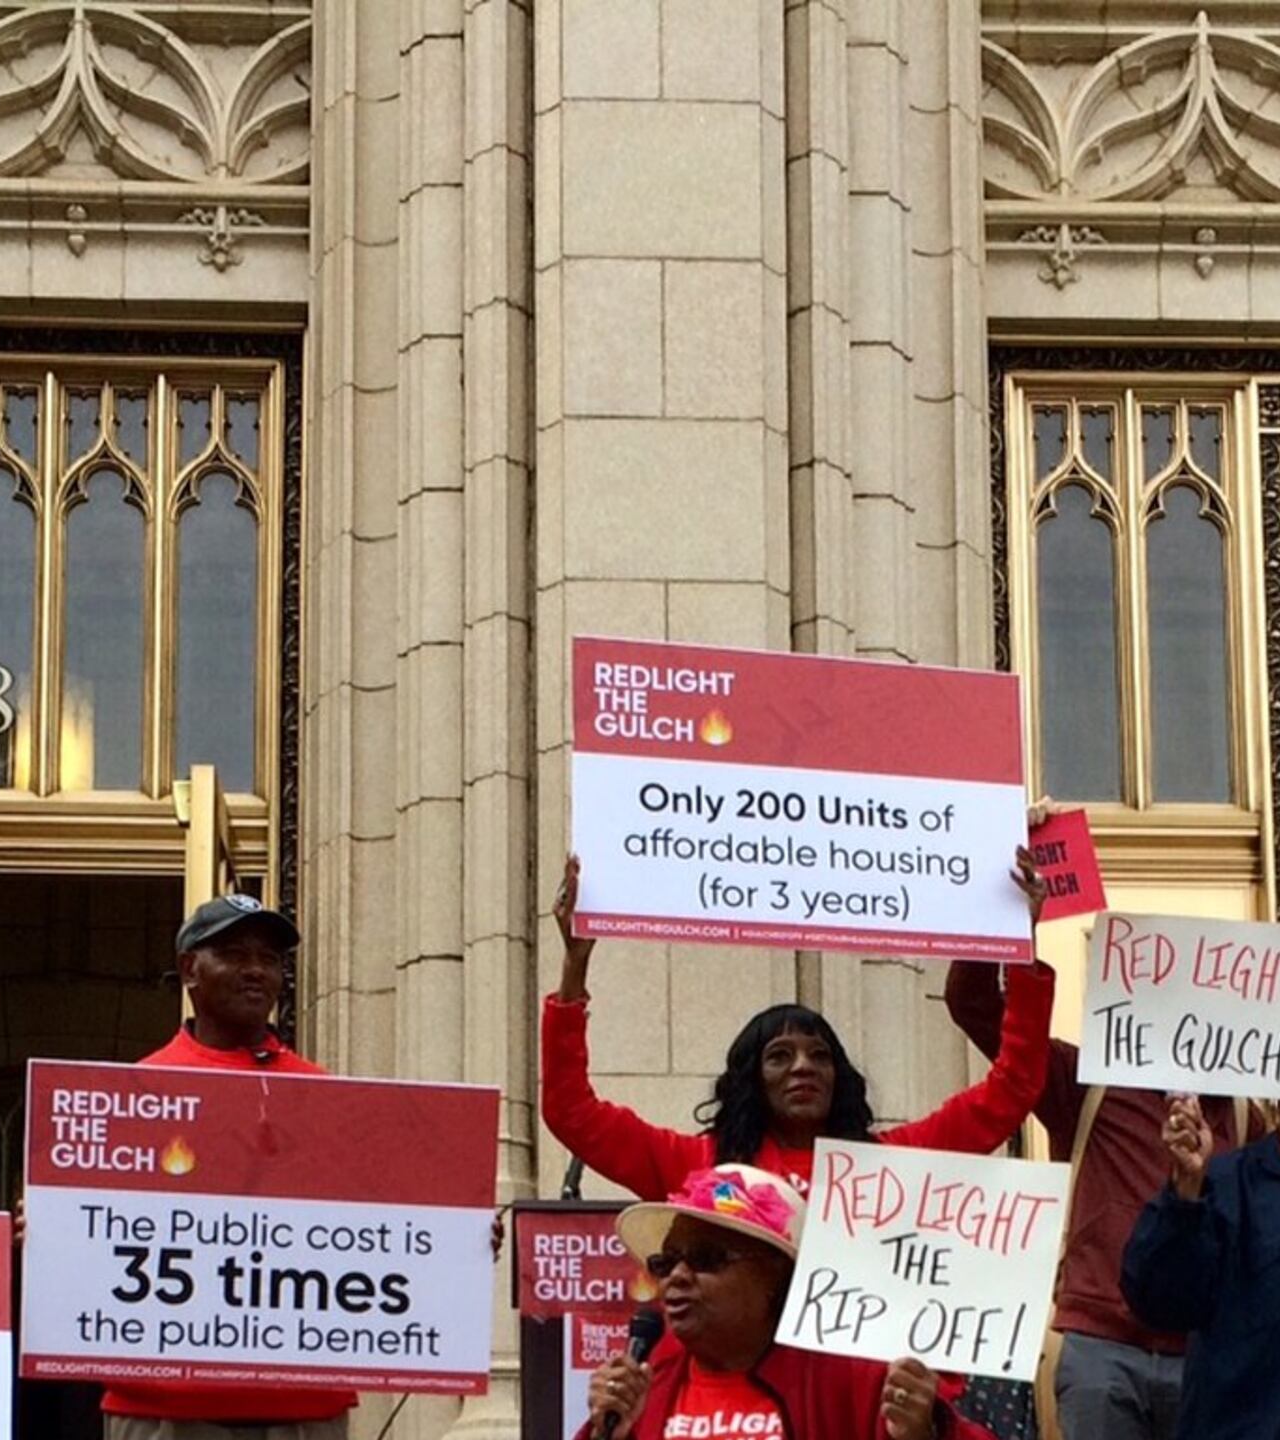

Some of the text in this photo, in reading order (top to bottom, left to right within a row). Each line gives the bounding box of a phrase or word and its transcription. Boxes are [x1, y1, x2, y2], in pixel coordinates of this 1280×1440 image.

[594, 662, 735, 696] REDLIGHT
[595, 687, 647, 713] THE
[594, 713, 693, 742] GULCH
[639, 783, 955, 831] Only 200 Units of
[623, 828, 970, 884] affordable housing
[697, 872, 911, 921] (for 3 years)
[1102, 916, 1175, 995] RED
[1093, 1000, 1154, 1068] THE
[53, 1089, 200, 1120] REDLIGHT
[52, 1117, 107, 1142] THE
[51, 1143, 154, 1172] GULCH
[823, 1151, 1059, 1256] RED LIGHT
[80, 1205, 432, 1256] The Public cost is
[534, 1234, 626, 1256] REDLIG
[111, 1246, 411, 1315] 35 times
[534, 1257, 582, 1278] THE
[880, 1232, 952, 1286] THE
[534, 1280, 624, 1301] GULCH
[77, 1311, 441, 1357] the public benefit
[793, 1267, 1027, 1372] RIP OFF!
